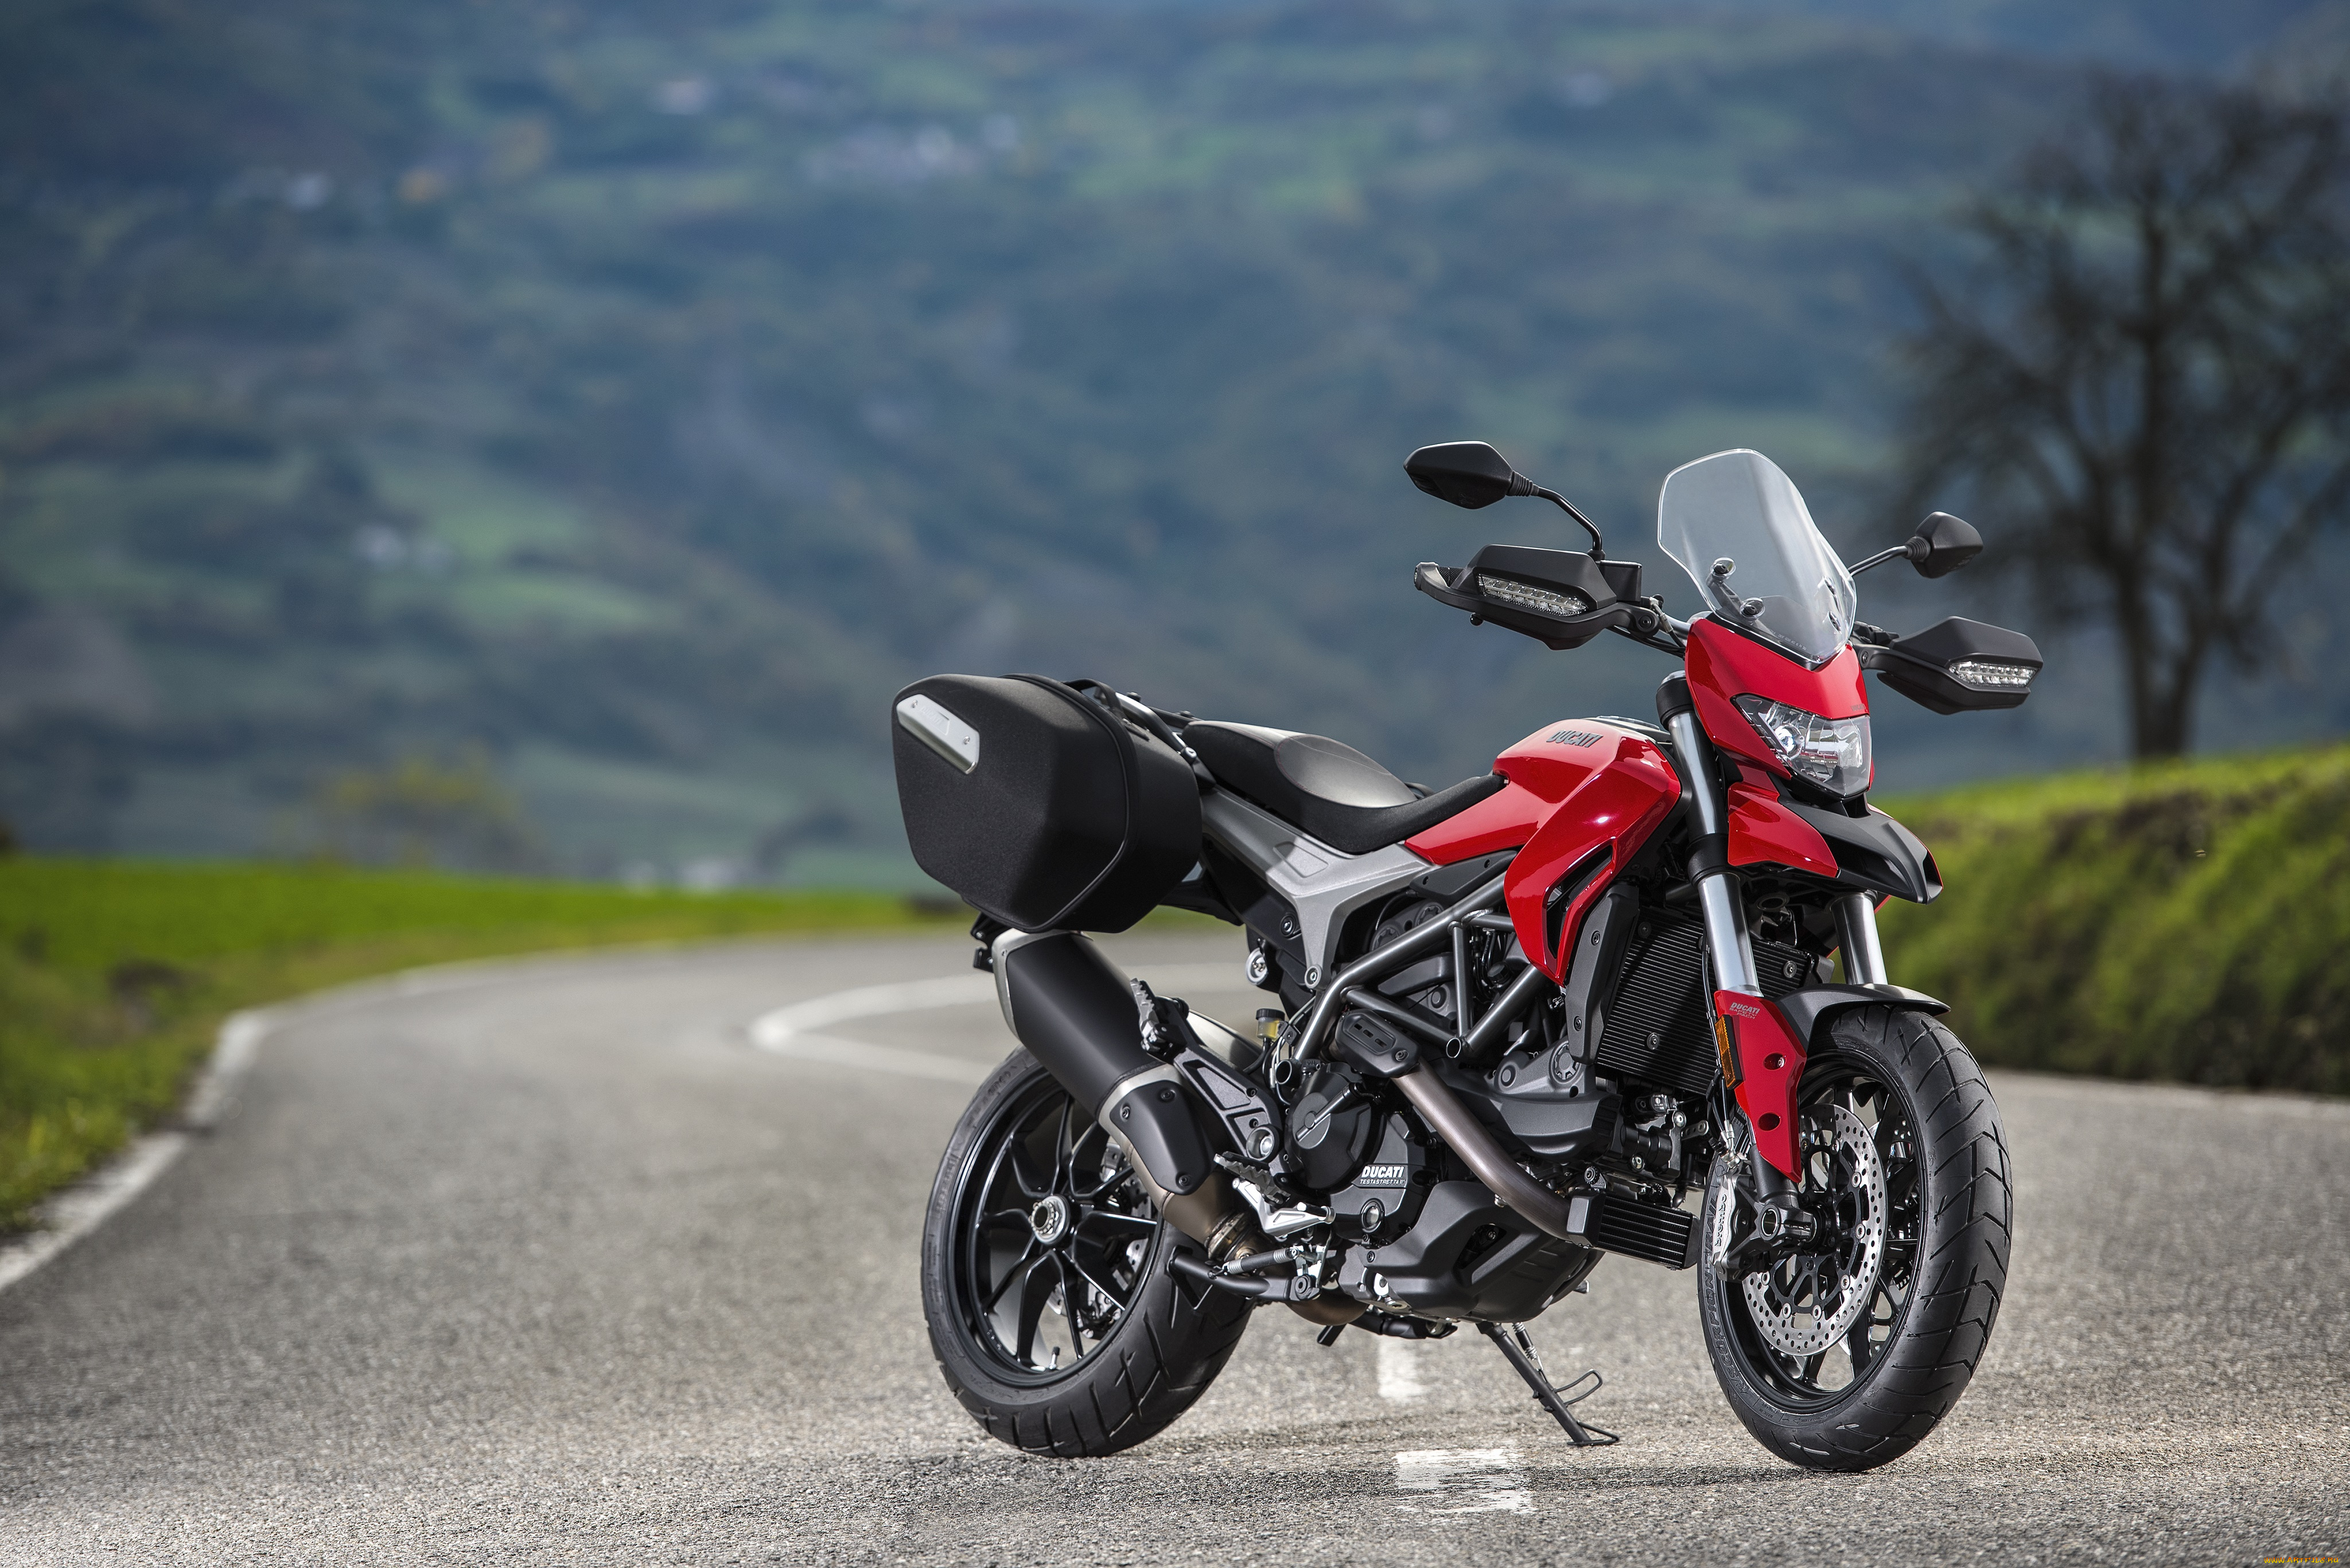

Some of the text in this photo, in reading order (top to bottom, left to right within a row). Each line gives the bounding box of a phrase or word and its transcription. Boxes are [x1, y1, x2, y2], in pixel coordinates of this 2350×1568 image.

[1546, 729, 1604, 748] DUCATI
[1729, 1007, 1757, 1017] SAFETY
[1730, 1002, 1761, 1014] DUCATI
[1361, 1166, 1404, 1178] DUCATI
[1714, 1194, 1727, 1247] brembo
[1704, 1195, 1738, 1378] SCORPION TRAIL
